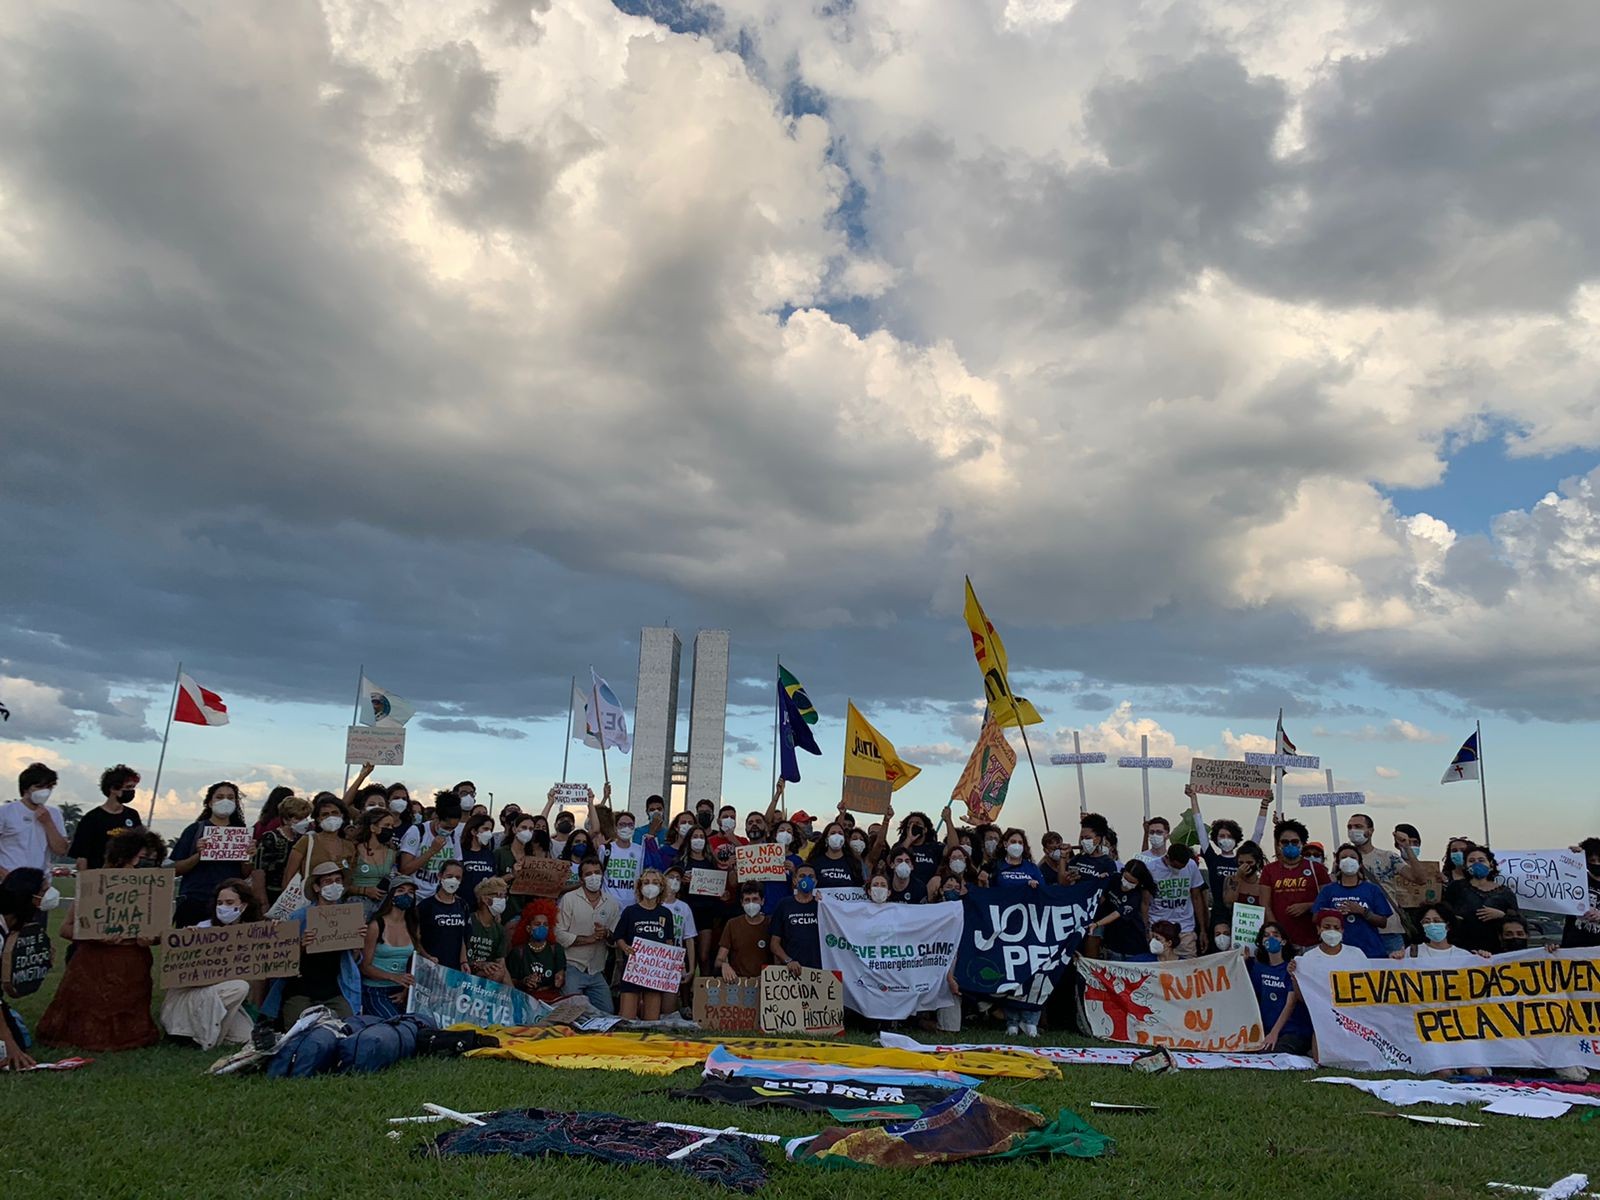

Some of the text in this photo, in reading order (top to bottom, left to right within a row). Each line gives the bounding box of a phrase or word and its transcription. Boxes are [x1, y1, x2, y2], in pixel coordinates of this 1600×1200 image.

[737, 844, 782, 859] EU NÃO
[608, 859, 637, 869] GREVE
[1508, 858, 1559, 880] FORA
[608, 869, 630, 879] PELO
[829, 872, 851, 880] CLIMA
[608, 879, 634, 890] CLIMA
[1159, 878, 1190, 889] GREVE
[798, 917, 817, 925] CLIM
[168, 932, 229, 948] QUANDO
[881, 945, 912, 958] PELO
[811, 971, 822, 983] DE
[1263, 979, 1286, 989] CLIMA
[1332, 970, 1463, 1004] LEVANTE
[1469, 965, 1520, 1000] DAS
[828, 981, 836, 1000] É
[456, 993, 511, 1027] GREVE
[764, 1004, 779, 1014] NO
[1184, 1008, 1213, 1030] OU
[1417, 1007, 1503, 1042] PELA
